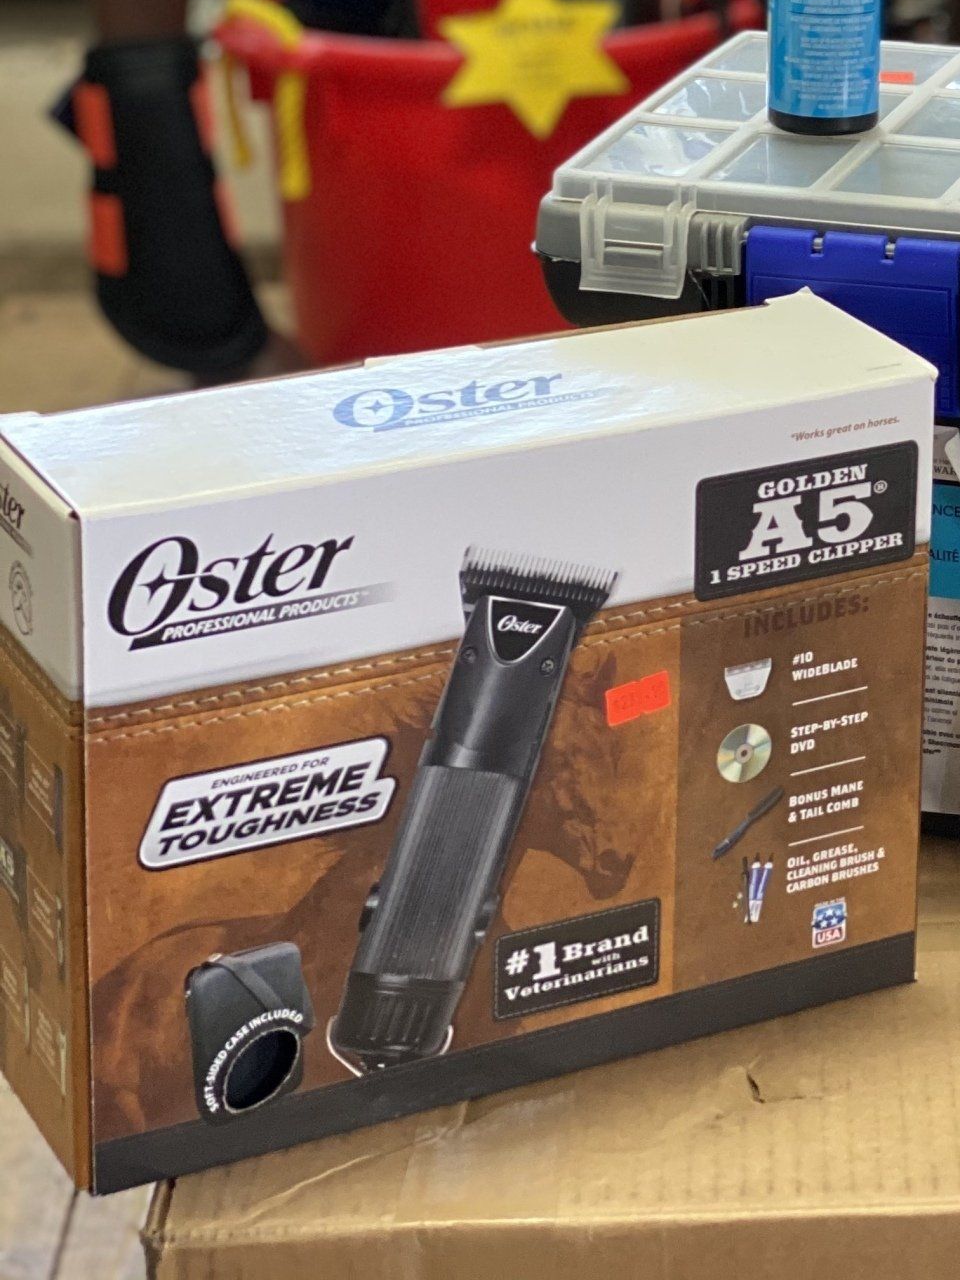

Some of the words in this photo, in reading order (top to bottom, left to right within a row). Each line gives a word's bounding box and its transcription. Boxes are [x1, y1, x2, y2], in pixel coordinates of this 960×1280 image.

[332, 373, 563, 428] Oster
[826, 424, 853, 439] great
[853, 422, 867, 432] on
[757, 463, 868, 500] GOLDEN
[709, 569, 722, 585] 1
[726, 552, 802, 582] SPEED
[808, 532, 904, 564] CLIPPER
[107, 532, 356, 637] Oster
[160, 609, 276, 642] PROFESSIONAL
[278, 590, 361, 620] PRODUCTS
[496, 614, 543, 635] Oster
[743, 594, 870, 639] INCLUDES:
[792, 651, 814, 666] #10
[790, 711, 869, 739] STEP-BY-STEP
[790, 739, 816, 755] DVD
[210, 763, 299, 790] ENGINEERED
[300, 756, 331, 770] FOR
[159, 761, 372, 833] EXTREME
[787, 811, 798, 824] &
[799, 805, 825, 820] TAIL
[826, 797, 860, 814] COMB
[788, 788, 829, 808] BONUS
[830, 780, 865, 798] MANE
[159, 791, 382, 857] TOUGHNESS
[785, 874, 835, 894] CARBON
[831, 861, 880, 882] BRUSHES
[786, 860, 838, 882] CLEANING
[838, 851, 876, 869] BRUSH
[876, 847, 886, 859] &
[504, 940, 561, 981] #1
[561, 925, 650, 963] Brand
[816, 928, 842, 943] USA
[590, 951, 622, 966] with
[504, 955, 651, 1002] Veterinarians
[224, 1025, 250, 1051] CASE
[248, 1007, 305, 1031] INCLUDED
